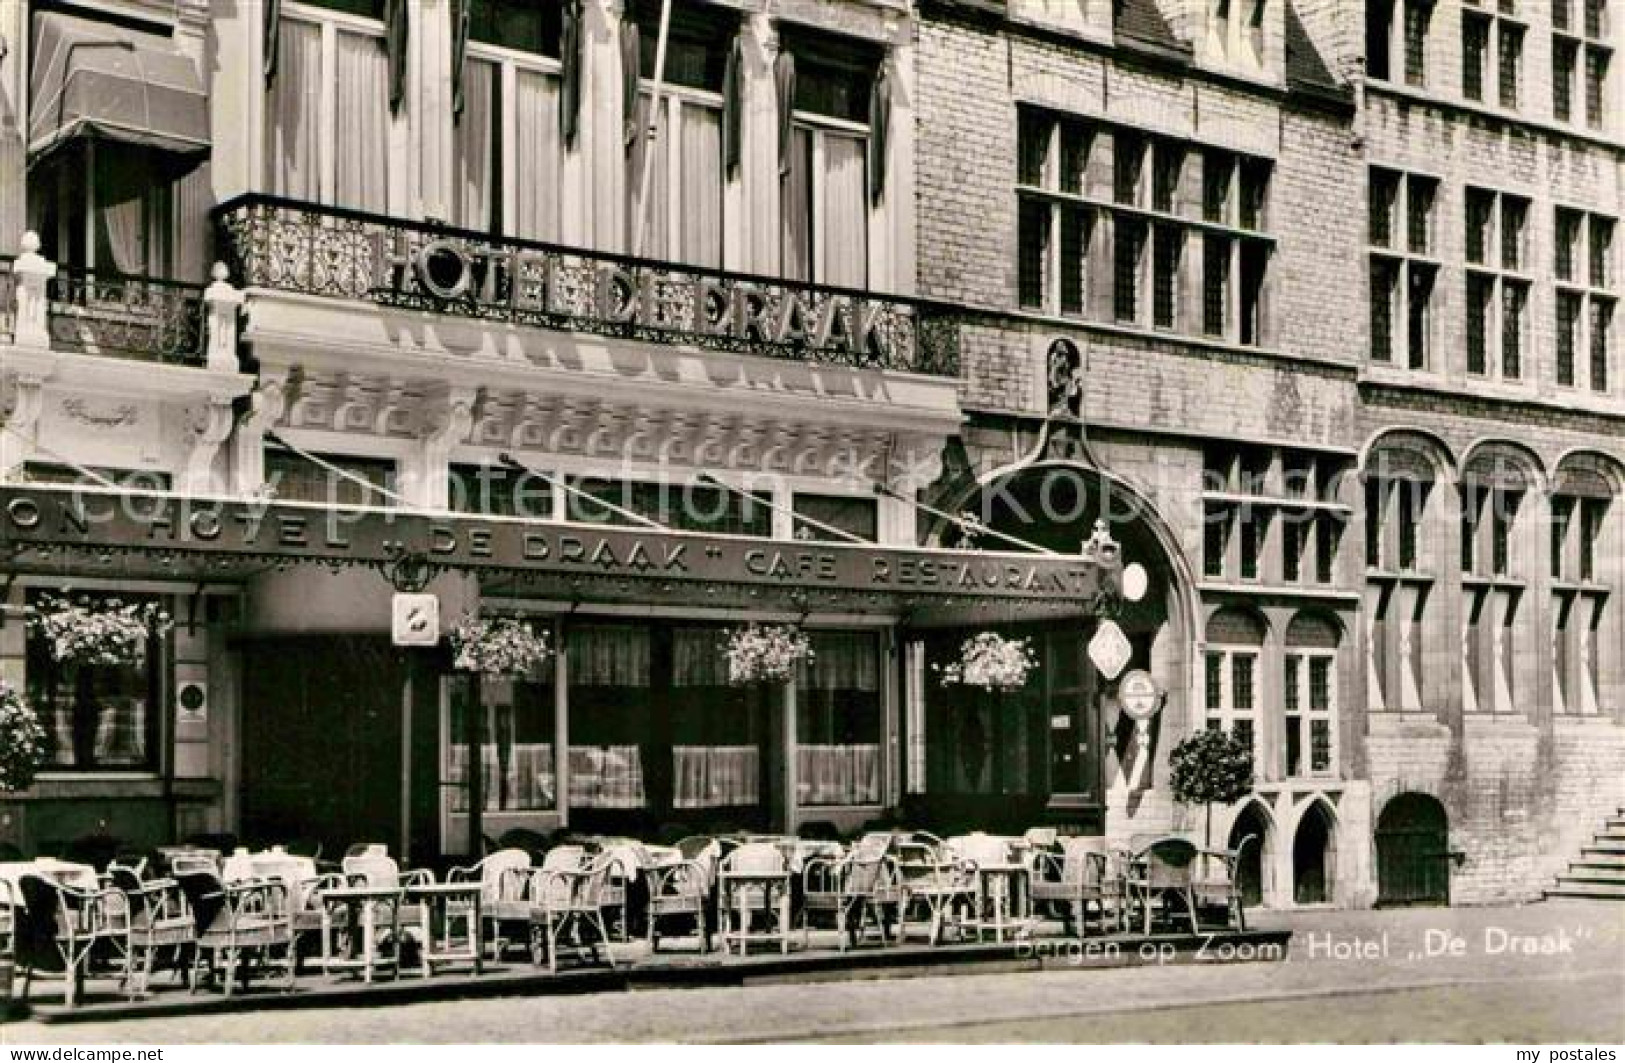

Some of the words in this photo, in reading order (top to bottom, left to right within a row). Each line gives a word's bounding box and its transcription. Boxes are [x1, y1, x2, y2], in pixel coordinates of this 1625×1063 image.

[370, 231, 566, 314] HOTEL
[600, 266, 686, 331] DE
[694, 276, 889, 356] DRAAK
[147, 502, 350, 549] HOTEL
[871, 556, 1089, 594] RESTAURANT
